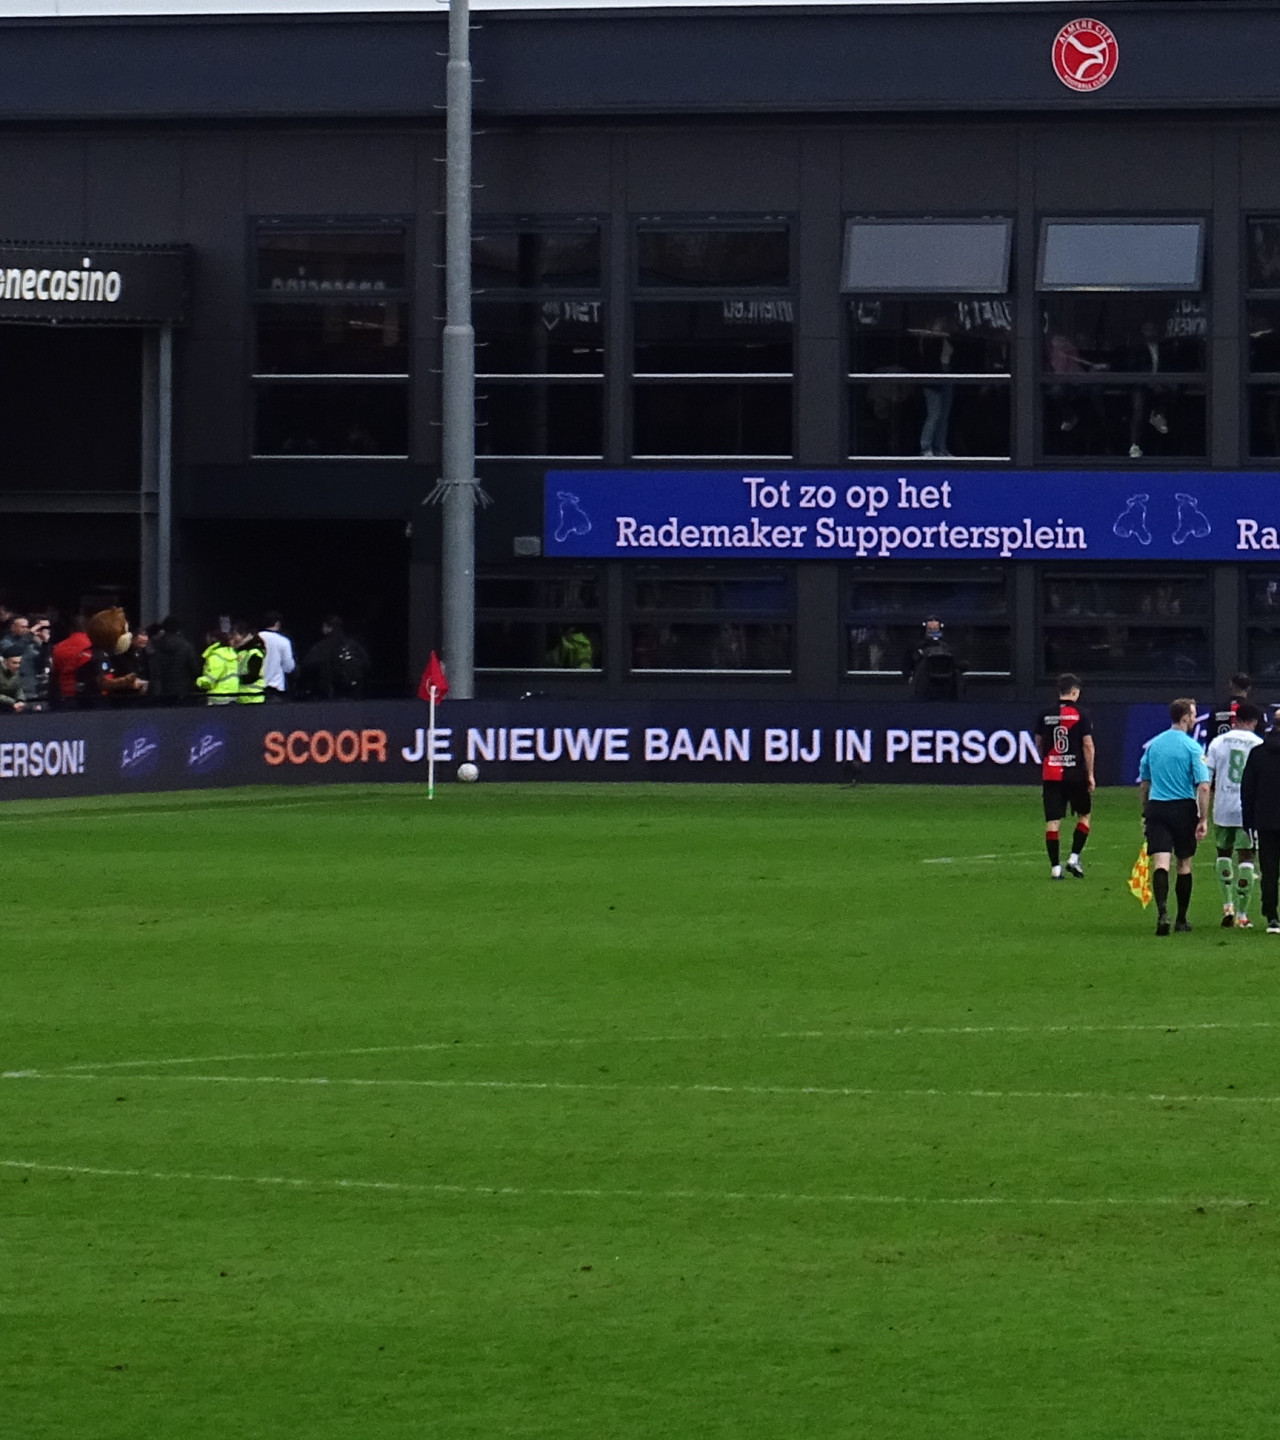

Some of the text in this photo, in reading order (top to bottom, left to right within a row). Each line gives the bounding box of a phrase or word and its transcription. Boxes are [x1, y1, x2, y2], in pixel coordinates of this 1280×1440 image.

[1058, 20, 1114, 45] ALMERE CITY
[743, 477, 952, 518] Tot zo op het
[616, 515, 1088, 559] Rademaker Supportersplein
[265, 729, 387, 766] SCOOR
[402, 727, 453, 763] JE
[466, 728, 630, 763] NIEUWE
[644, 728, 750, 763] BAAN
[764, 728, 821, 764] BIJ
[836, 729, 872, 764] IN
[1053, 725, 1070, 754] 6
